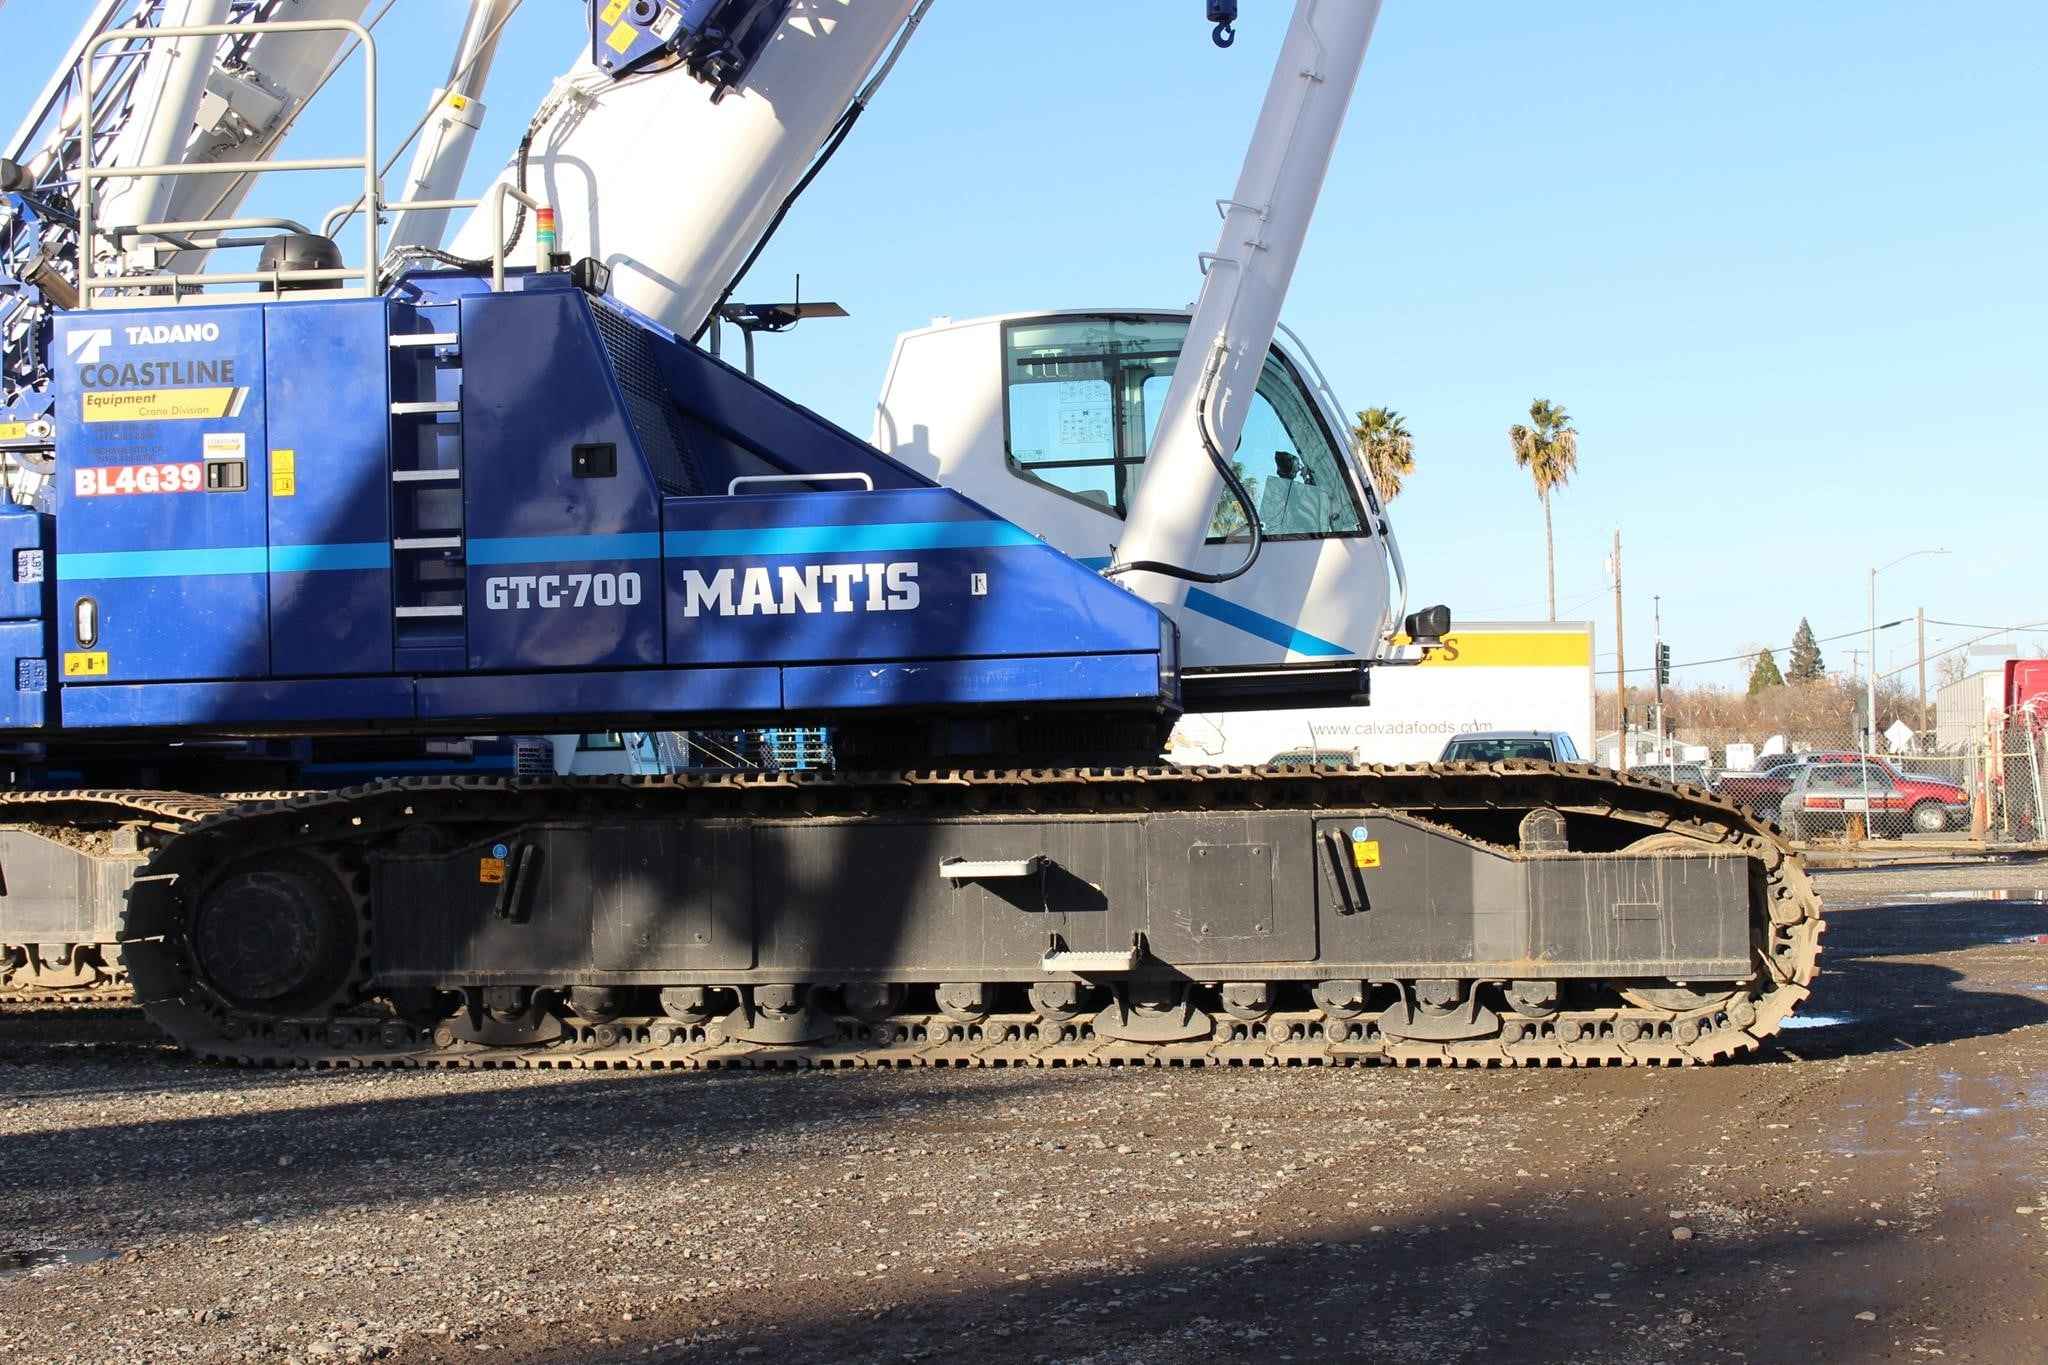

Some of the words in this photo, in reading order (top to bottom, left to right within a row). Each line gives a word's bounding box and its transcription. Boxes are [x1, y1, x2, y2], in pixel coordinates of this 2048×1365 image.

[126, 323, 219, 344] TADANO
[79, 359, 234, 388] COASTLINE
[86, 393, 157, 408] Equipment
[75, 464, 202, 496] BL4G39
[486, 572, 642, 610] GTC-700
[683, 562, 920, 617] MANTIS
